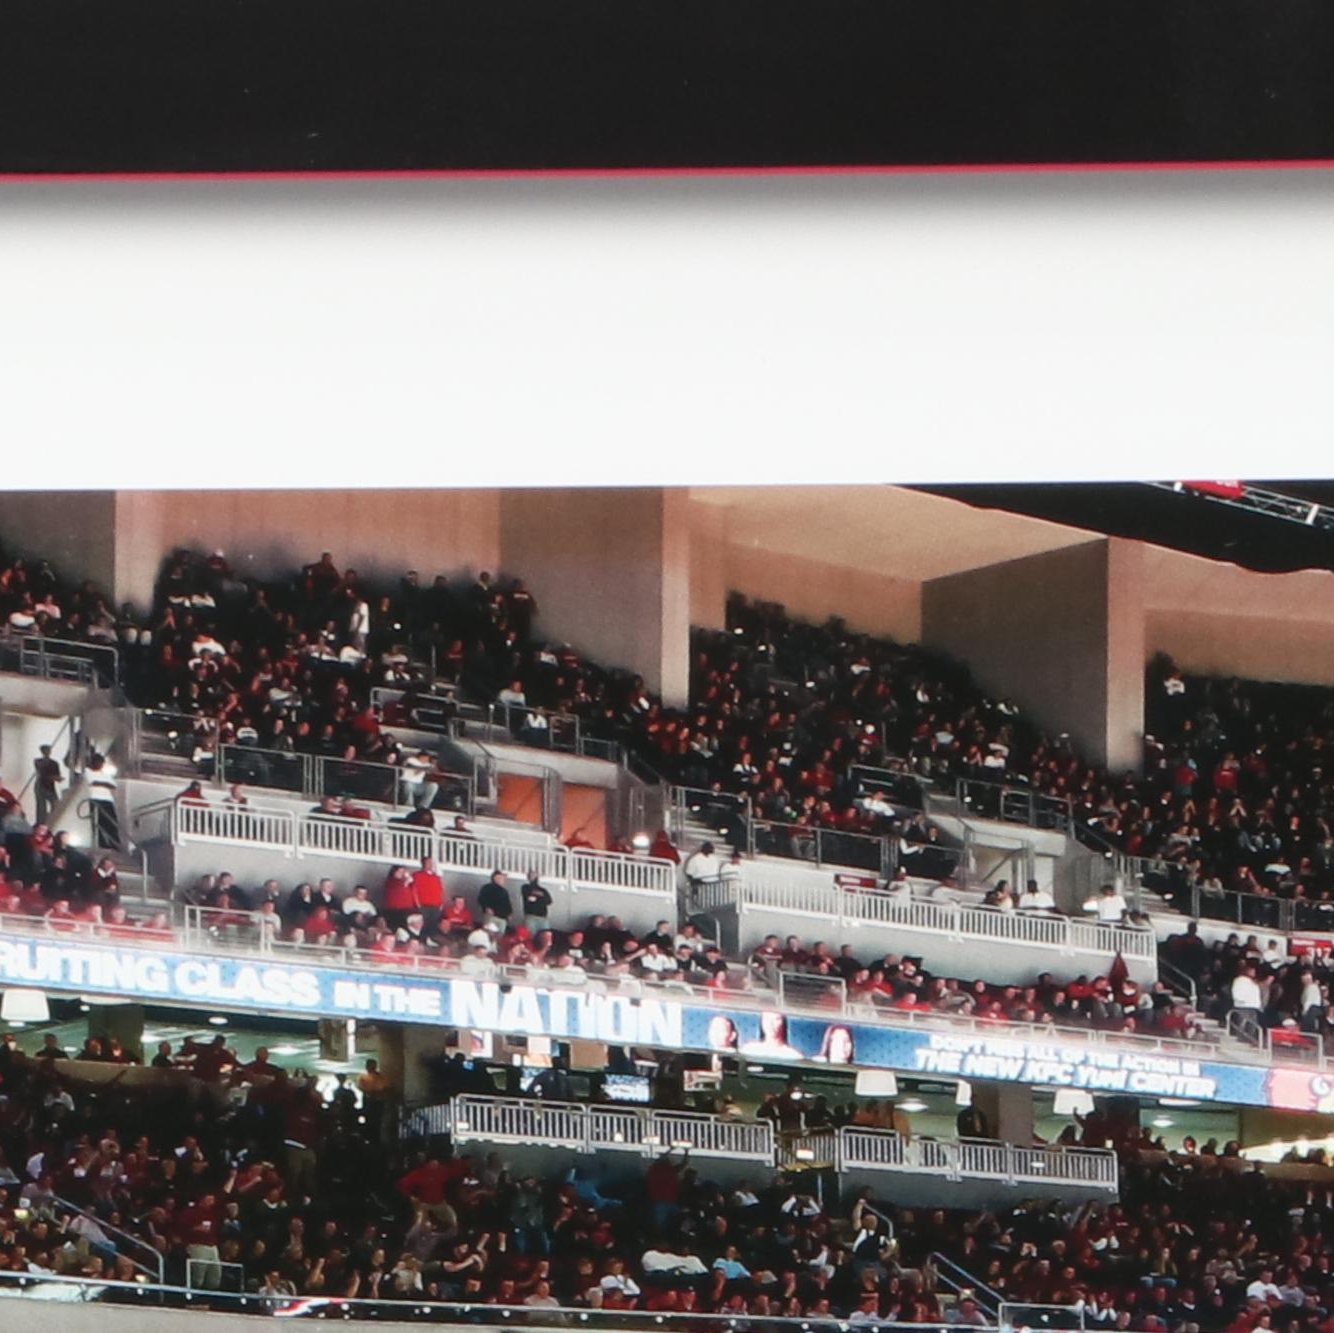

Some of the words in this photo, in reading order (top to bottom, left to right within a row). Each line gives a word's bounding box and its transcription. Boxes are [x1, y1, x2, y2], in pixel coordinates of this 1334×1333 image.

[175, 959, 321, 1007] CLASS
[333, 981, 376, 1012] IN
[378, 984, 441, 1017] THE
[450, 979, 683, 1048] NATION
[915, 1048, 965, 1075] THE
[966, 1053, 1023, 1081] NEW
[1129, 1069, 1217, 1100] CENTER
